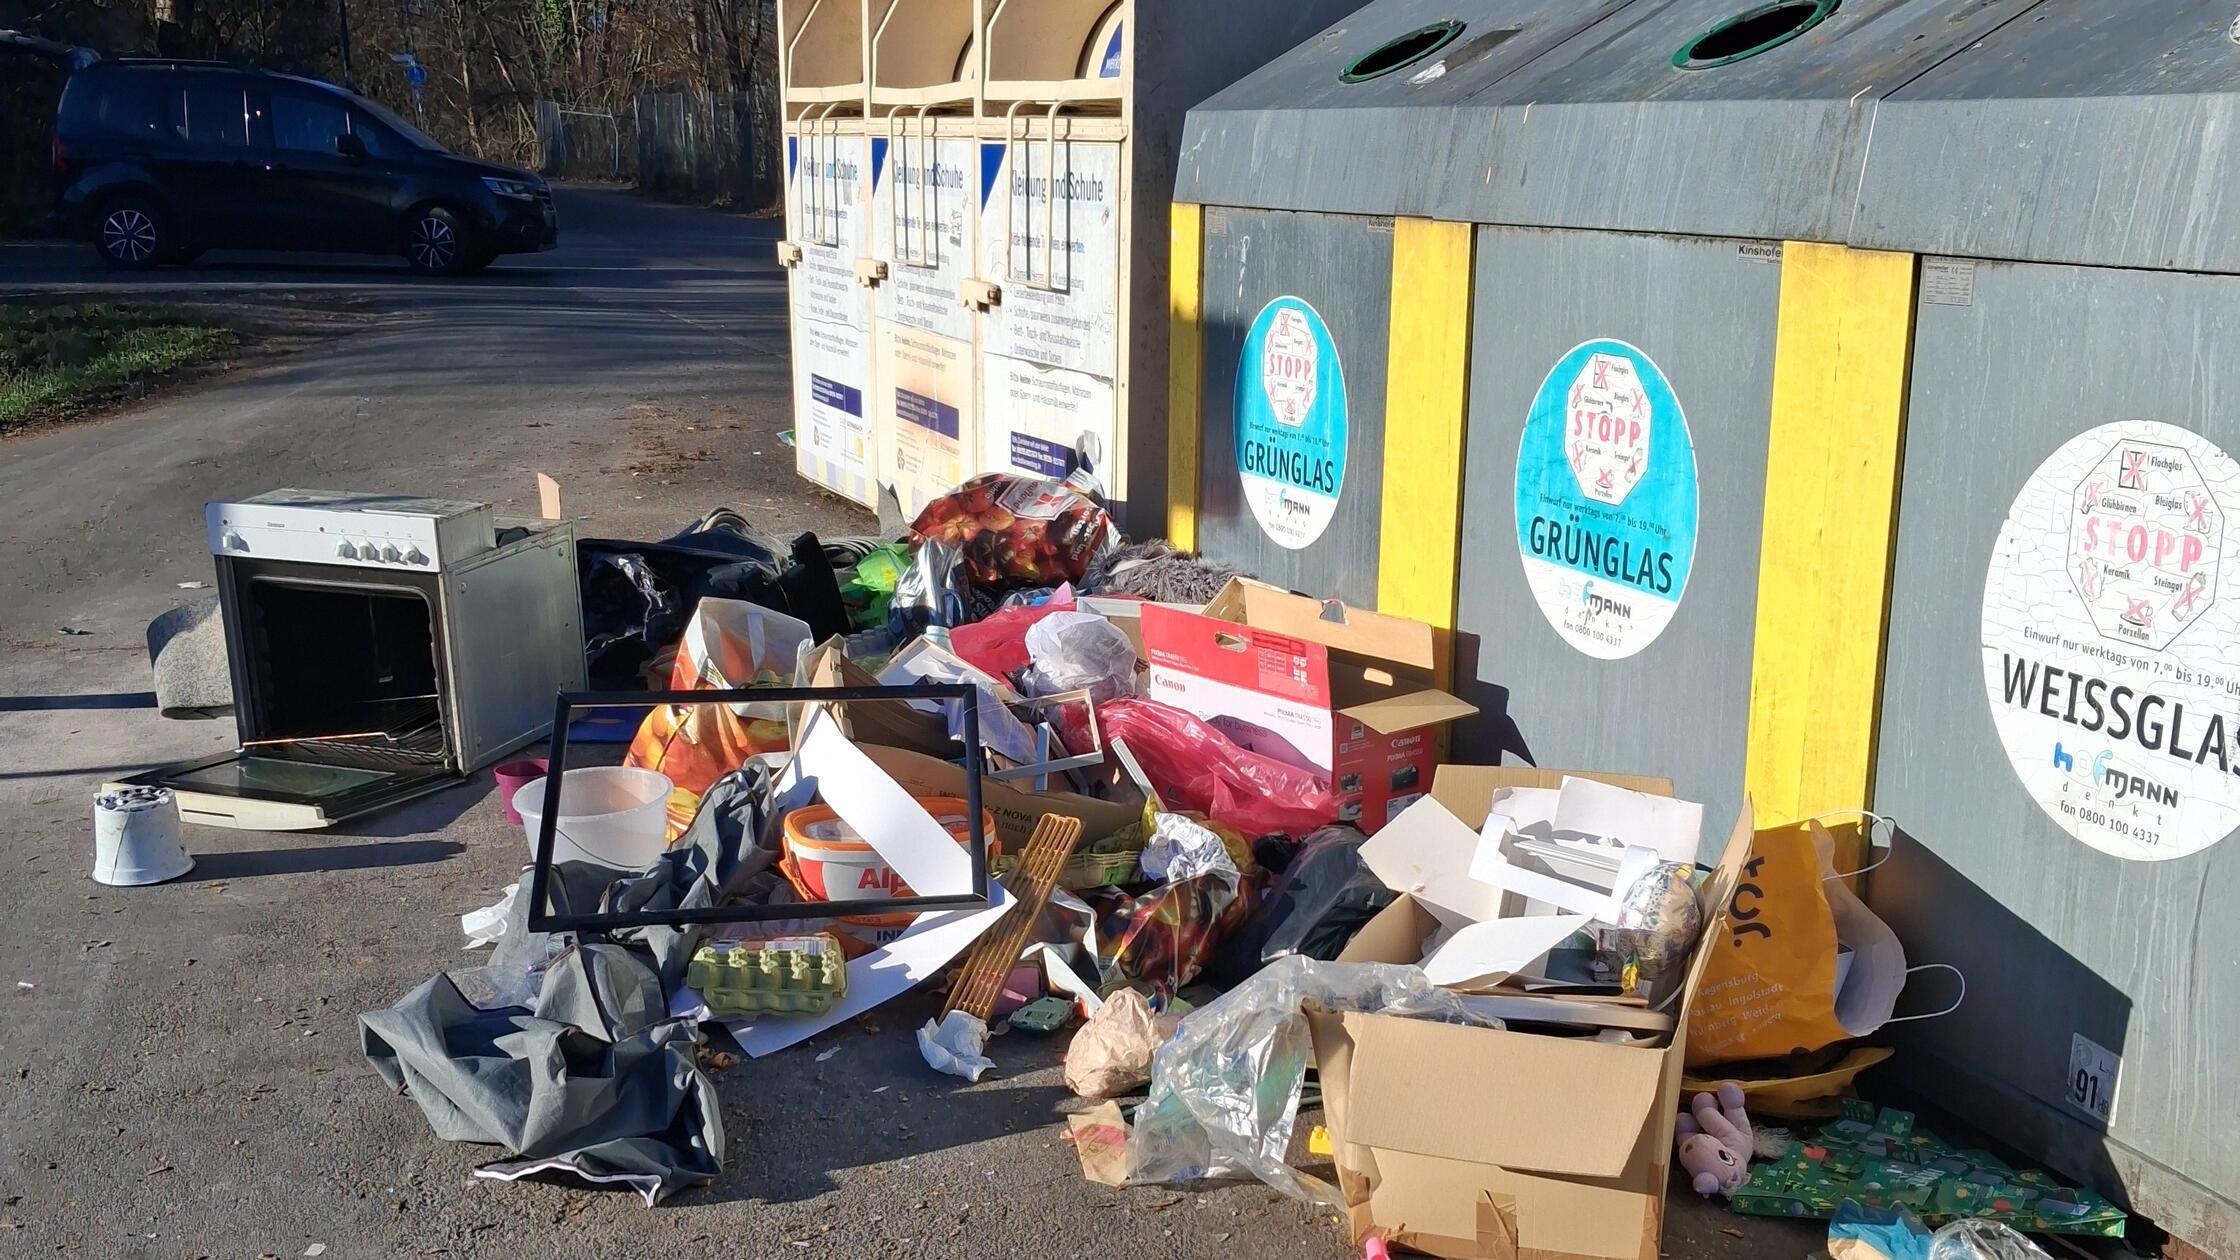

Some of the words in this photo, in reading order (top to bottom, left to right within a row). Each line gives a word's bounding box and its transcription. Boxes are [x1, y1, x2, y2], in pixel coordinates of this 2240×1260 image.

[1068, 172, 1103, 203] Schuhe
[1738, 244, 1782, 258] Kinshofe
[1269, 353, 1311, 381] STOPP
[1574, 409, 1642, 448] STOPP
[1244, 436, 1334, 494] GRÜNGLAS
[2151, 456, 2183, 472] Flachglas
[1013, 481, 1042, 510] aufland
[1602, 510, 1613, 521] von
[1627, 516, 1638, 528] bis
[1530, 513, 1674, 594] GRÜNGLAS
[2083, 516, 2203, 573] STOPP
[2103, 564, 2131, 579] Keramik
[1574, 624, 1591, 637] 0800
[1592, 629, 1604, 642] 100
[2118, 623, 2150, 641] Porzellan
[2024, 626, 2061, 646] Einwurf
[2062, 637, 2079, 651] nur
[2082, 643, 2127, 667] werktags
[2130, 657, 2149, 672] von
[2176, 667, 2192, 683] bis
[2226, 680, 2240, 696] Uh
[1155, 674, 1186, 693] Canon
[1391, 735, 1421, 748] Canon
[1003, 807, 1032, 824] NOVA
[2060, 800, 2076, 817] fon
[2079, 807, 2106, 826] 0800
[2109, 818, 2129, 835] 100
[2132, 826, 2160, 846] 4337
[858, 867, 907, 896] Alp
[2075, 1068, 2099, 1109] 91
